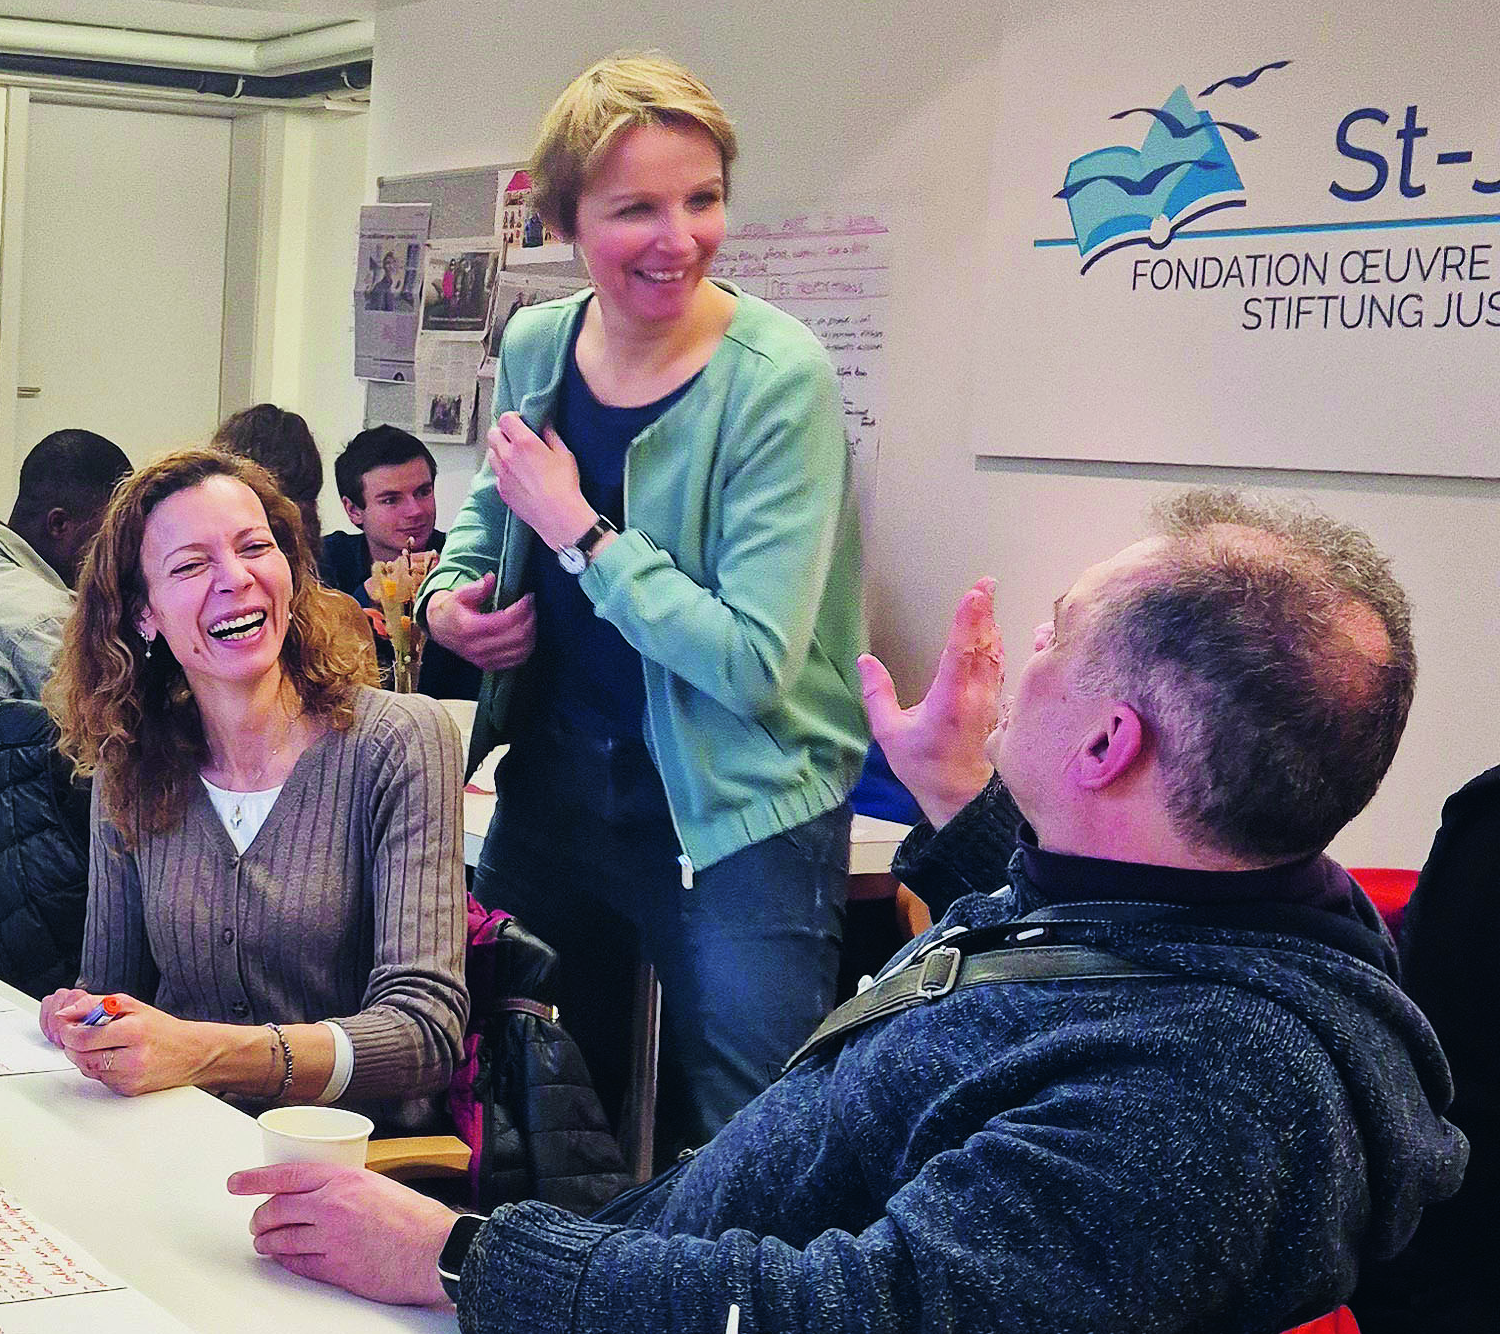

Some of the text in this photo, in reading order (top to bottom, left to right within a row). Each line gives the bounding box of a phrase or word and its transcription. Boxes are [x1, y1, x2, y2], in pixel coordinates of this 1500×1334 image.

[1132, 244, 1494, 291] FONDATION ŒUVRE
[1242, 293, 1424, 331] STIFTUNG
